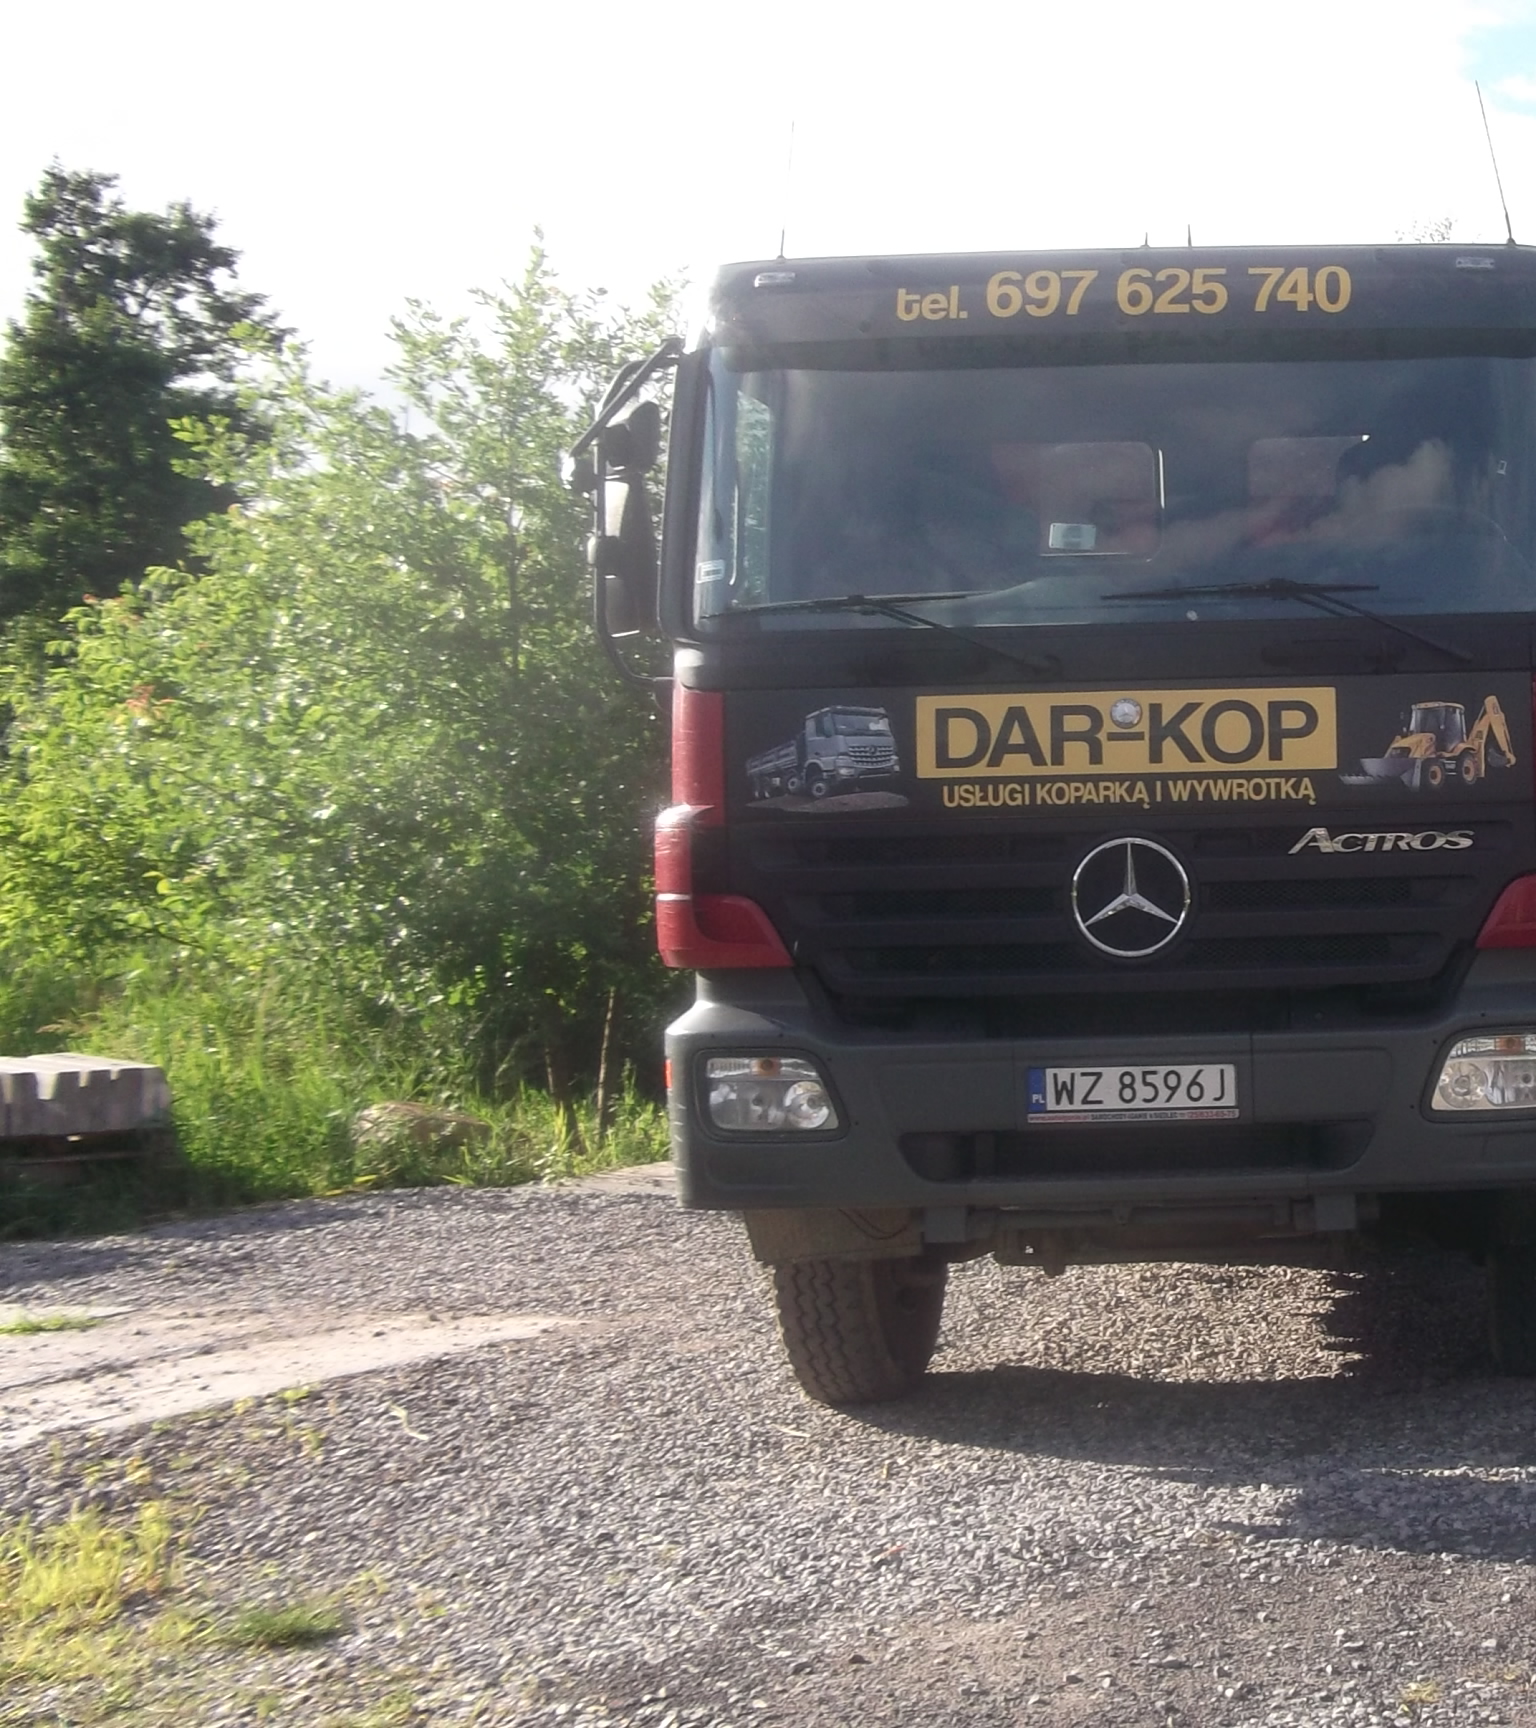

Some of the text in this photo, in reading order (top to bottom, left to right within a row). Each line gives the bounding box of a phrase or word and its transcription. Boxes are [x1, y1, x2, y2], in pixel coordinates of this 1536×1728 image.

[895, 265, 1352, 322] tel. 697 625 740
[935, 699, 1319, 769] DAR-KOP
[942, 776, 1317, 810] USŁUGI KOPARKĄ I WYWROTKĄ
[1032, 1093, 1046, 1104] PL
[1053, 1068, 1226, 1106] WZ 8596J
